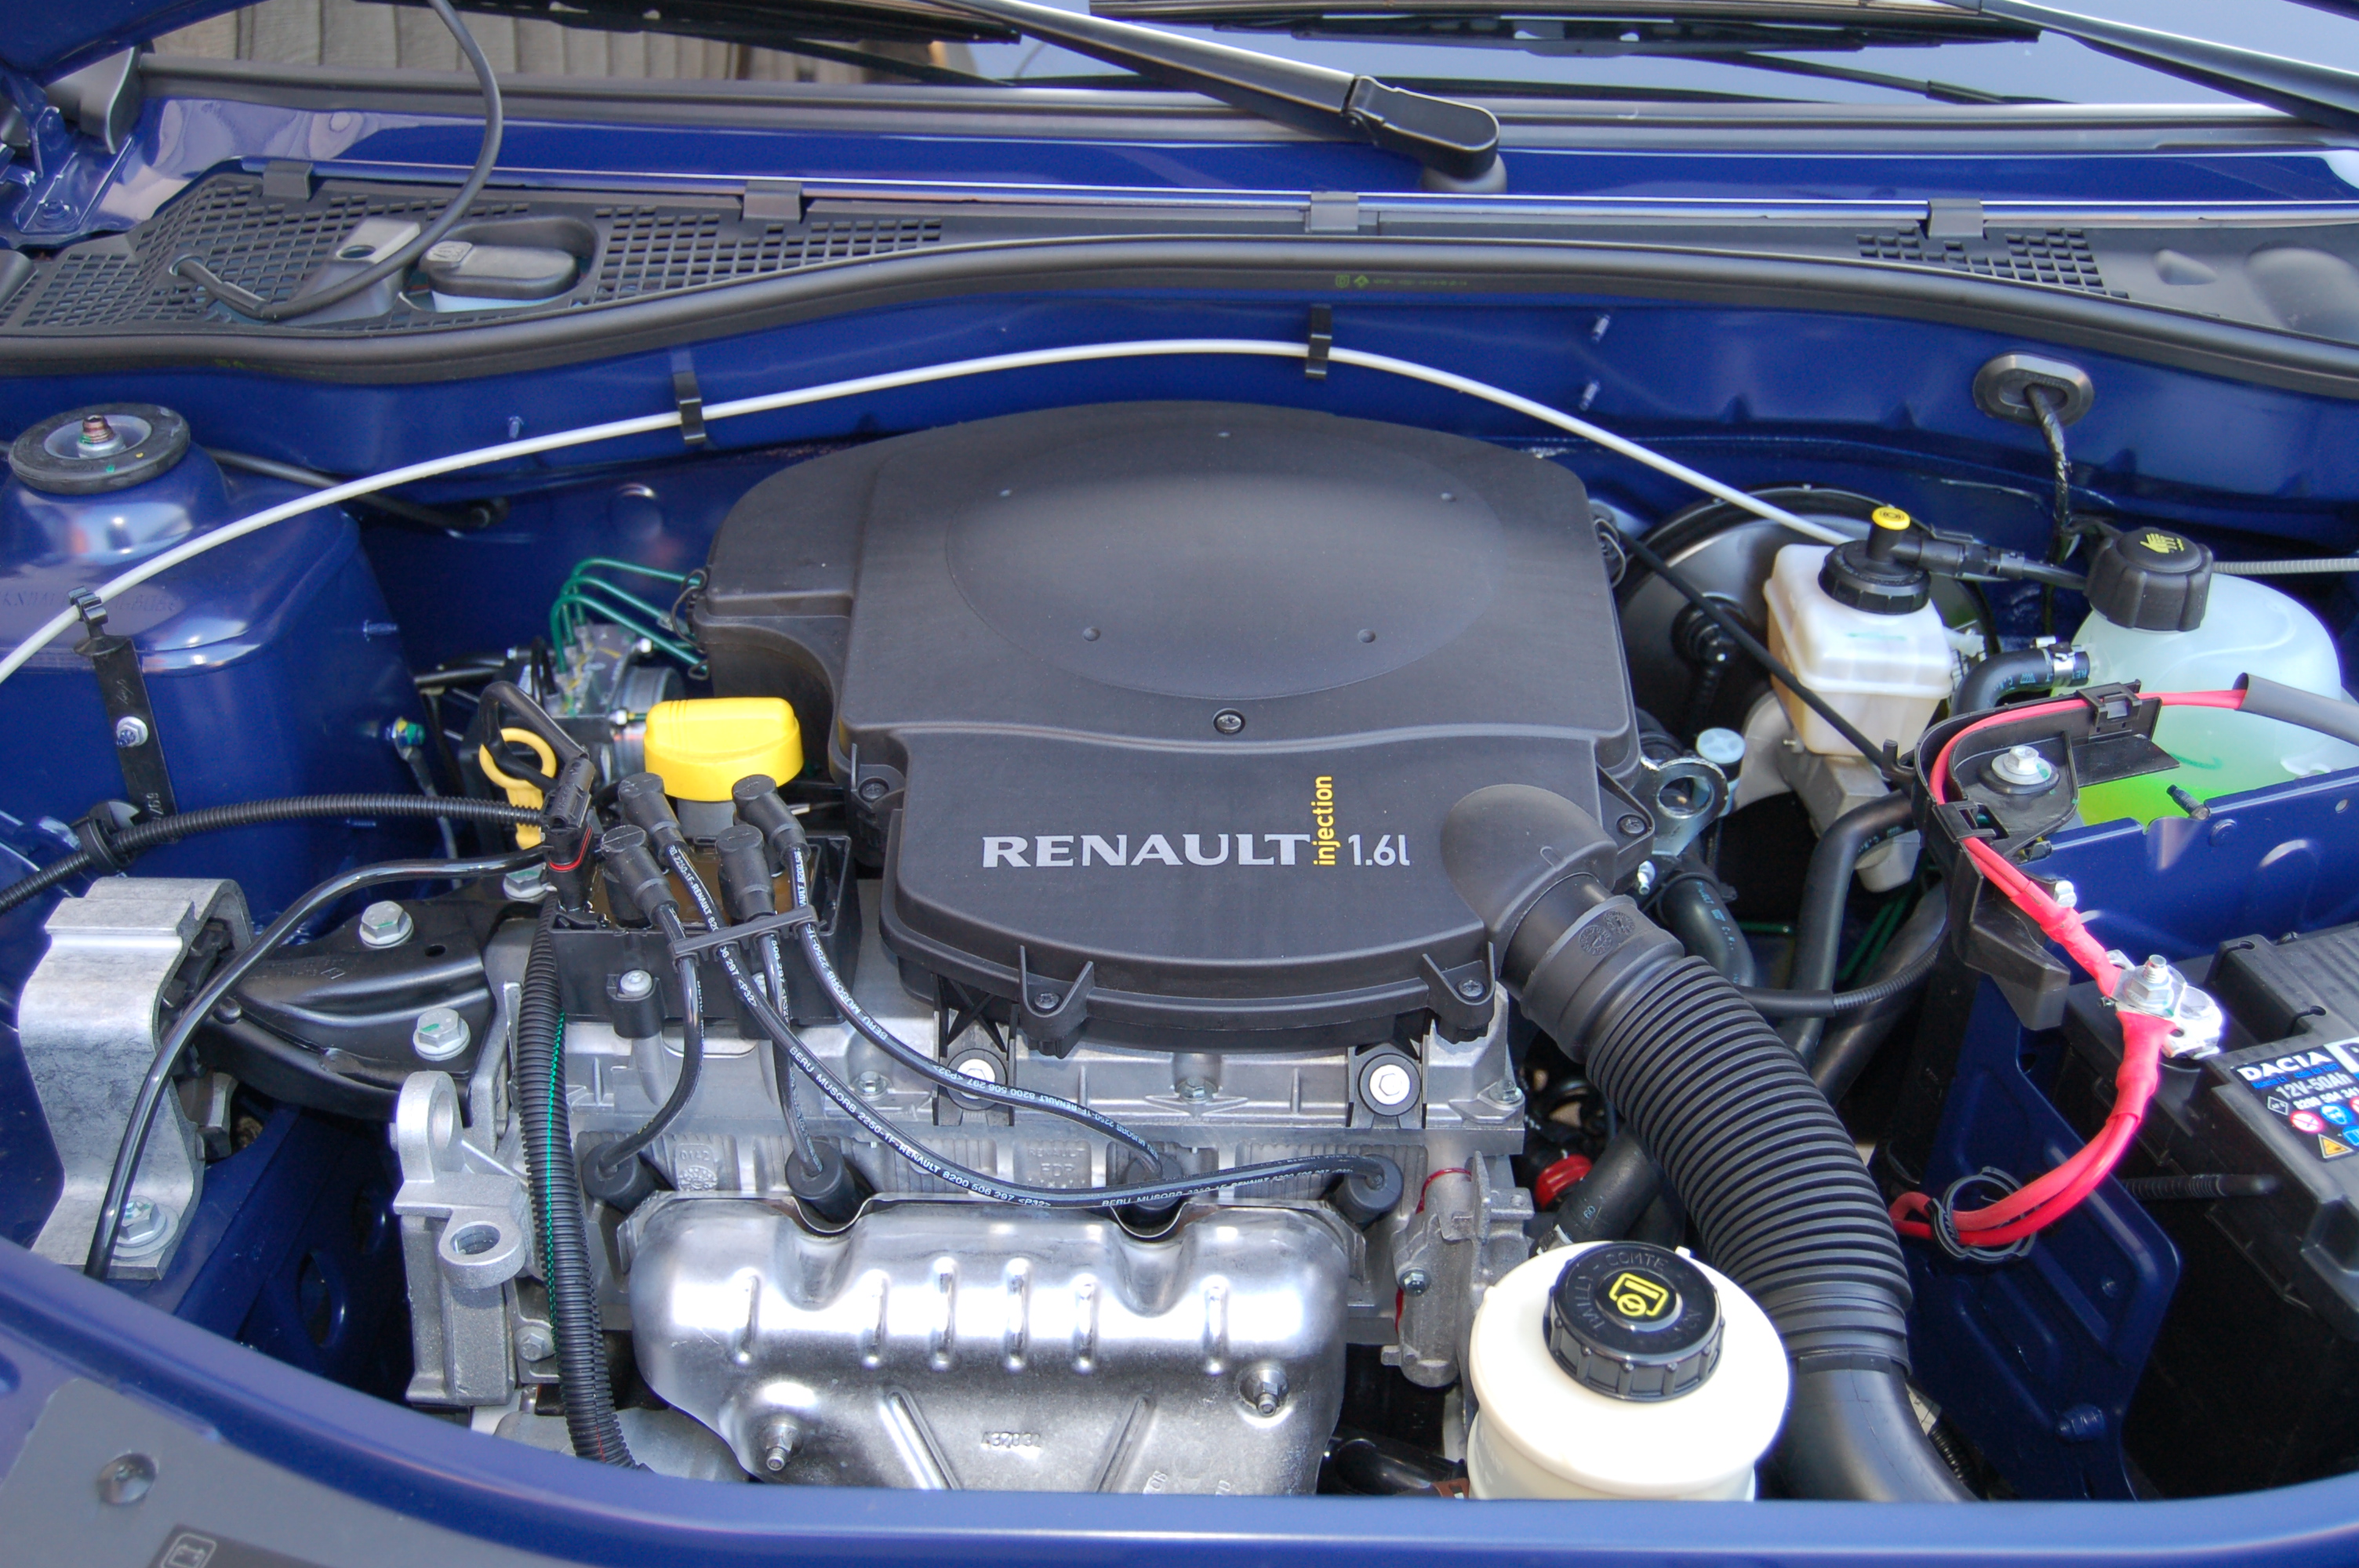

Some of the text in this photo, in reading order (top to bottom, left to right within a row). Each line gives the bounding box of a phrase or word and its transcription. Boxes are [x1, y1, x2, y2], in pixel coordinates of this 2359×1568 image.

[1311, 775, 1340, 866] injection
[982, 833, 1410, 868] RENAULT 1.6l
[827, 971, 861, 1014] MUSORB
[863, 1016, 889, 1040] BERU
[2237, 1051, 2333, 1081] DACIA
[966, 1078, 987, 1089] 297
[988, 1083, 1008, 1094] 506
[1010, 1087, 1036, 1100] 8200
[2276, 1072, 2354, 1099] 12V-50Ah
[2293, 1096, 2322, 1111] 8200
[2319, 1091, 2344, 1104] 504
[789, 1046, 815, 1073] BERU
[816, 1073, 857, 1113] MUSORB
[942, 1170, 969, 1188] 8200
[971, 1182, 992, 1196] 506
[993, 1190, 1015, 1203] 297
